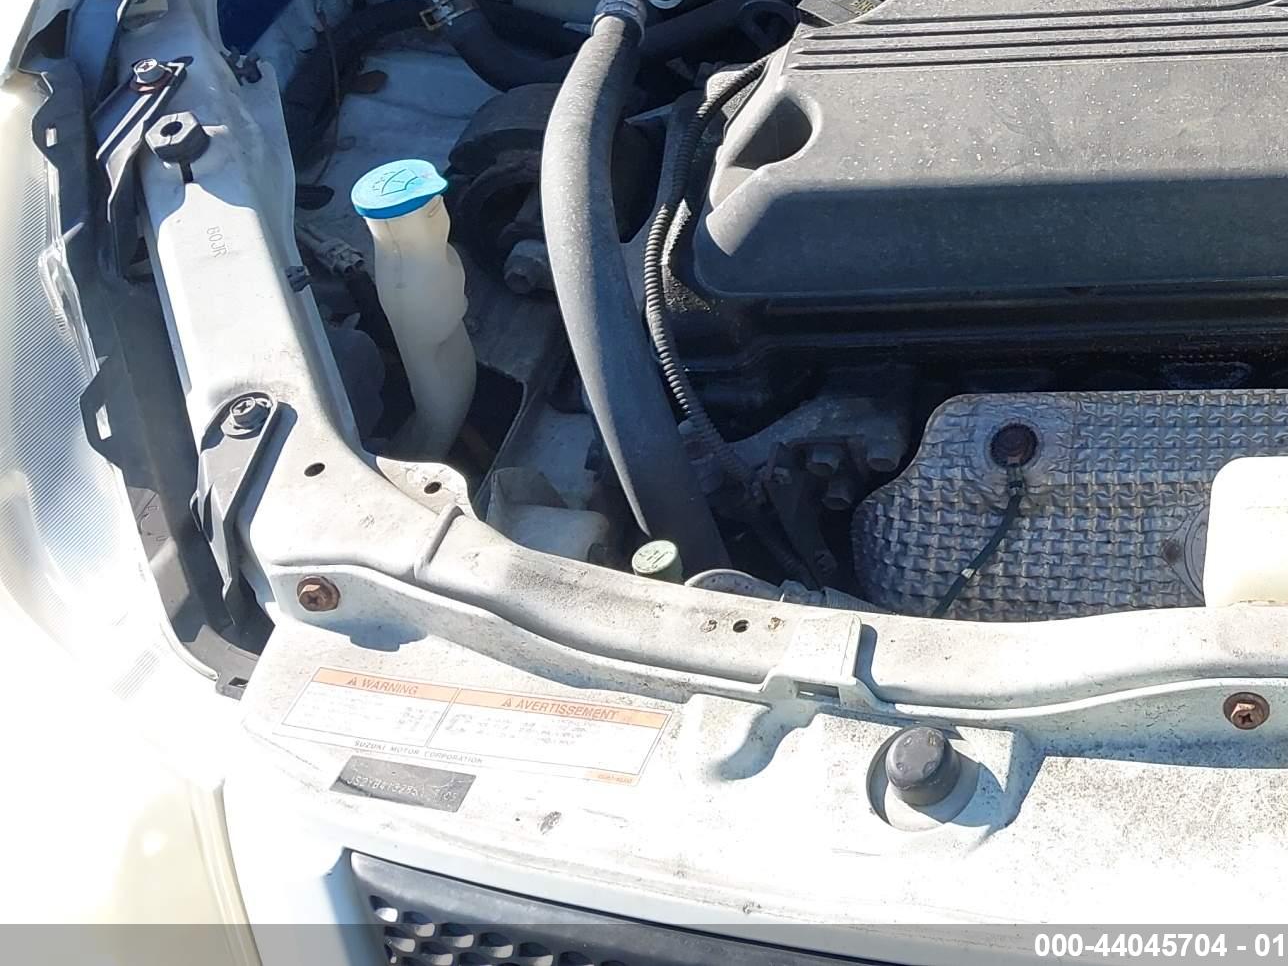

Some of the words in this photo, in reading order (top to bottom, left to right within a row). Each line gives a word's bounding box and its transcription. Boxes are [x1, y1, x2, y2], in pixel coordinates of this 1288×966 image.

[361, 677, 419, 695] WARNING
[514, 698, 619, 721] AVERTISSEMENT
[354, 740, 386, 751] SUZUKI
[390, 746, 421, 755] MOTOR
[424, 750, 483, 764] CORPORATION
